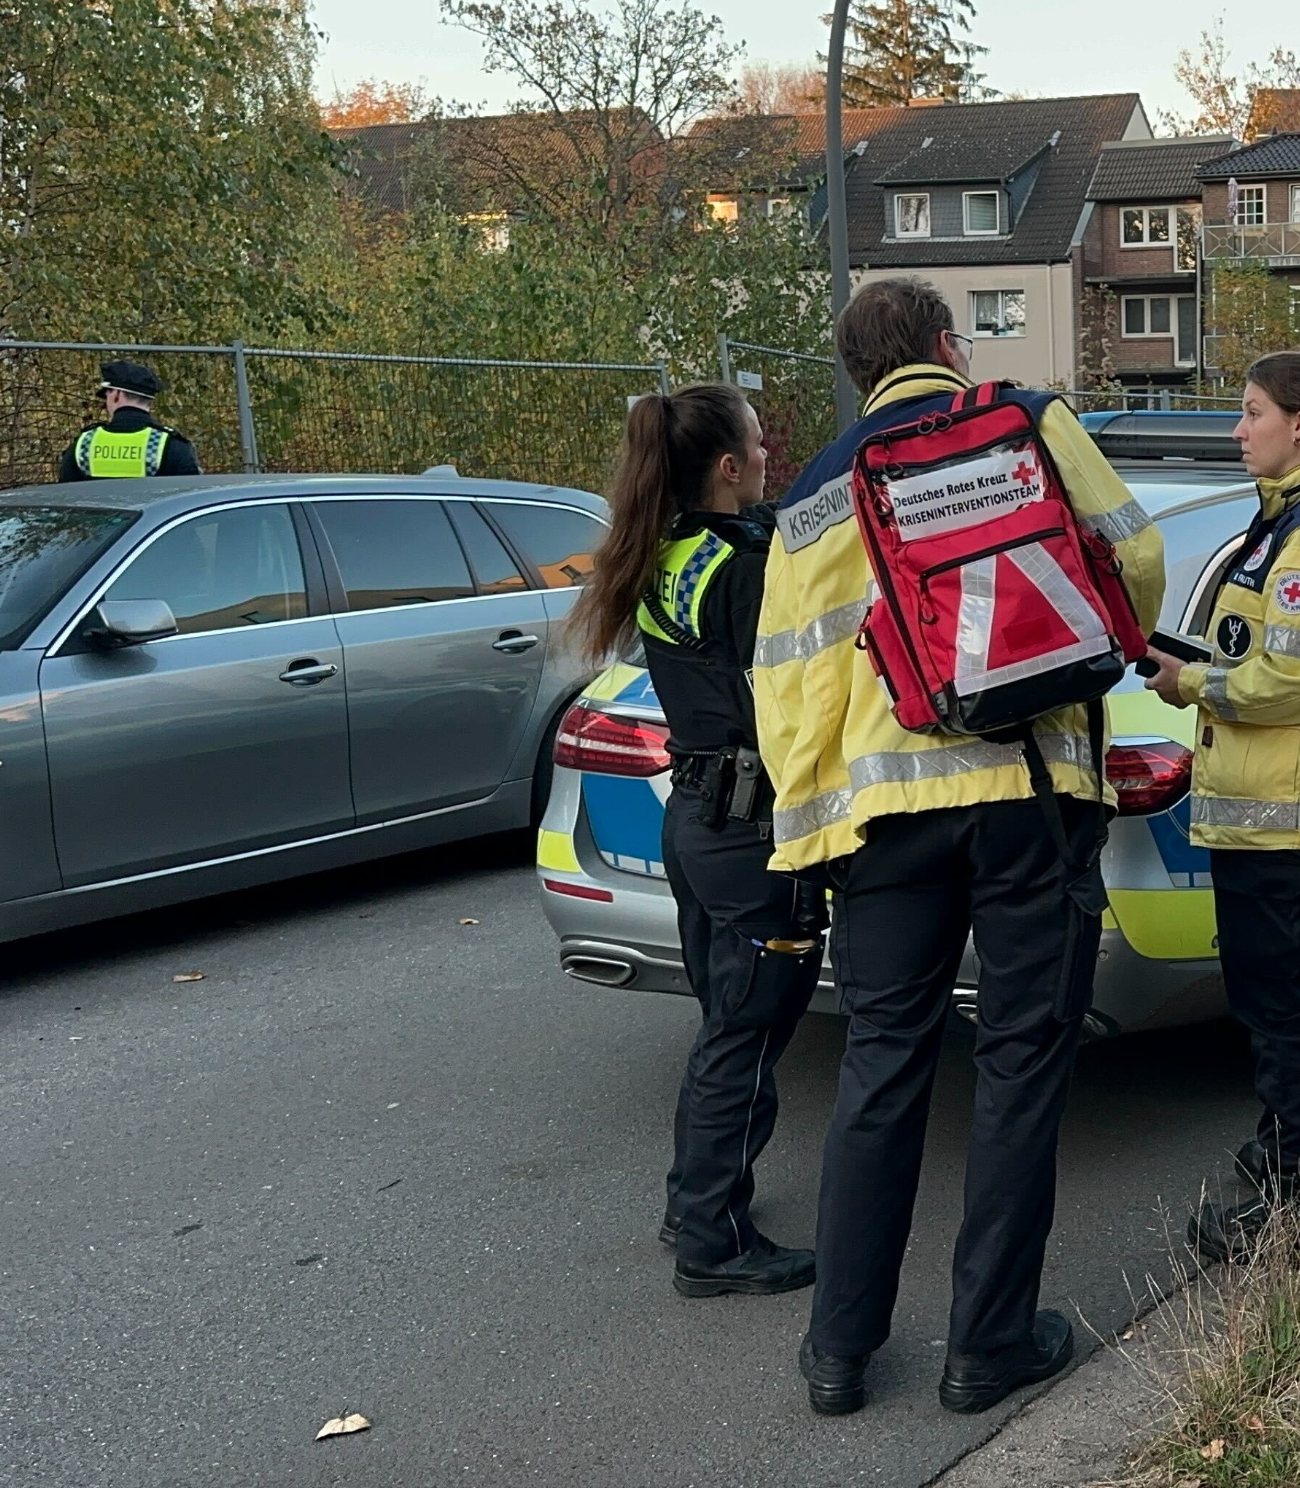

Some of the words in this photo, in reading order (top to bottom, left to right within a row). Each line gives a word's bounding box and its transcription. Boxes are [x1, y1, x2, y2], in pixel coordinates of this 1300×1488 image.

[93, 445, 142, 460] POLIZEI
[893, 487, 945, 508] Deutsches
[946, 481, 975, 496] Rotes
[977, 473, 1008, 488] Kreuz
[898, 484, 1041, 527] KRISENINTERVENTIONSTEAM
[1276, 590, 1290, 609] ROTES
